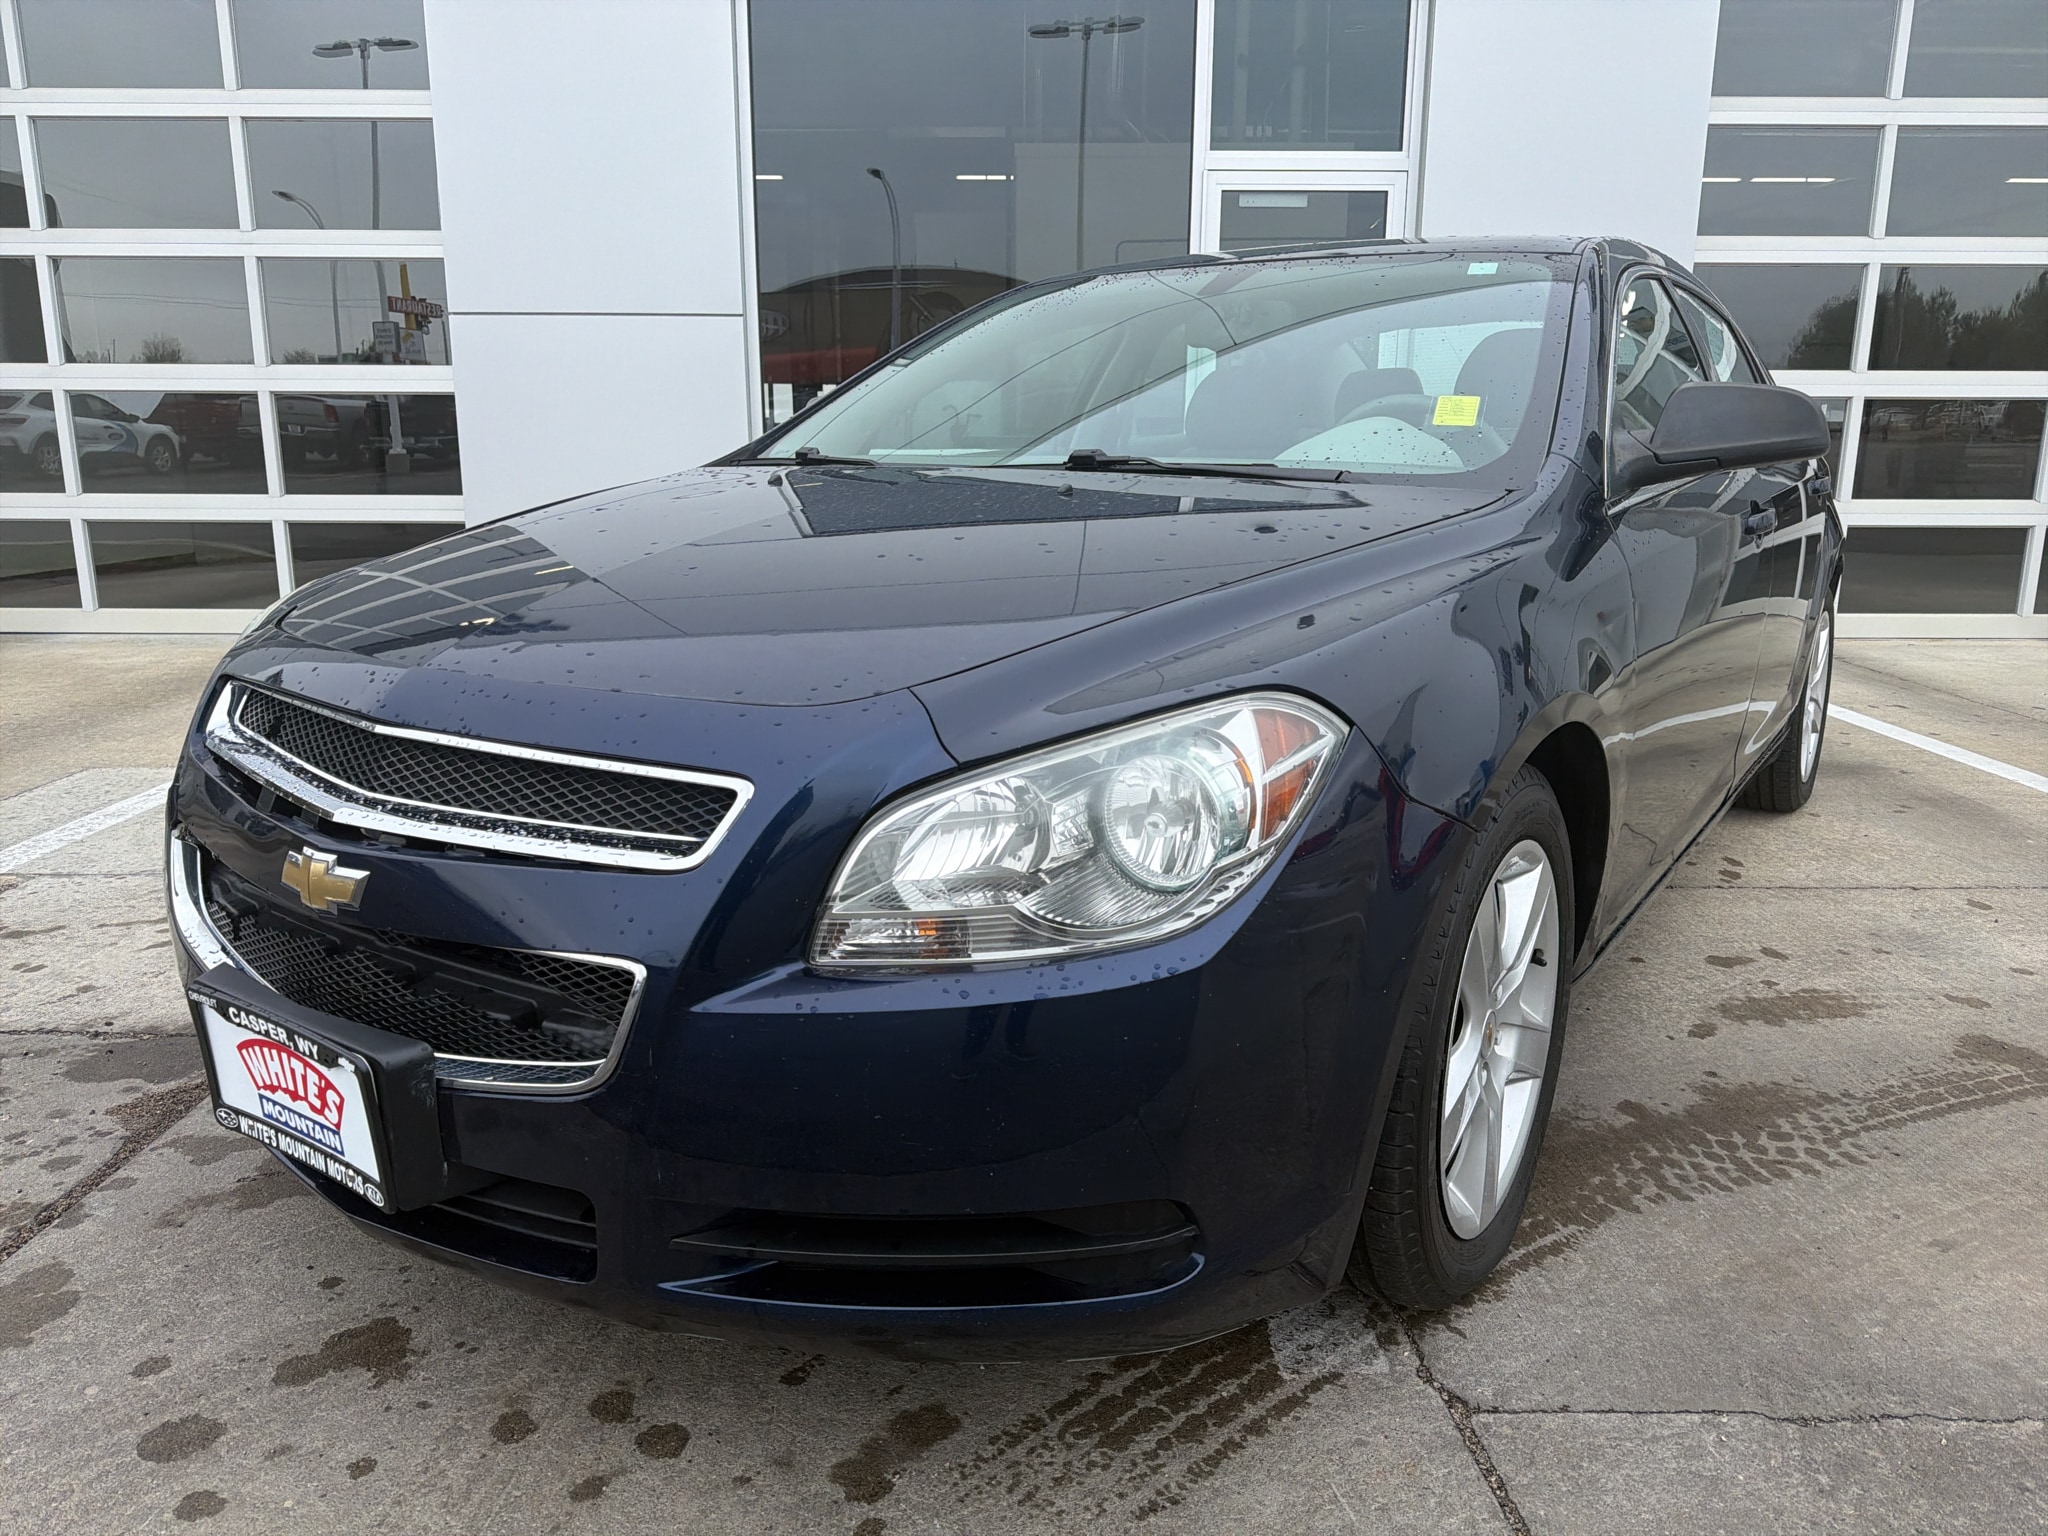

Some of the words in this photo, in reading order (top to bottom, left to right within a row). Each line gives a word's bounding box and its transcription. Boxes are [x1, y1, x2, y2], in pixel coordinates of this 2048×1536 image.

[228, 1006, 294, 1050] CASPER,
[294, 1035, 318, 1060] WY
[241, 1046, 341, 1125] WHITE'S
[263, 1098, 342, 1152] MOUNTAIN
[278, 1133, 326, 1173] MOUNTAIN
